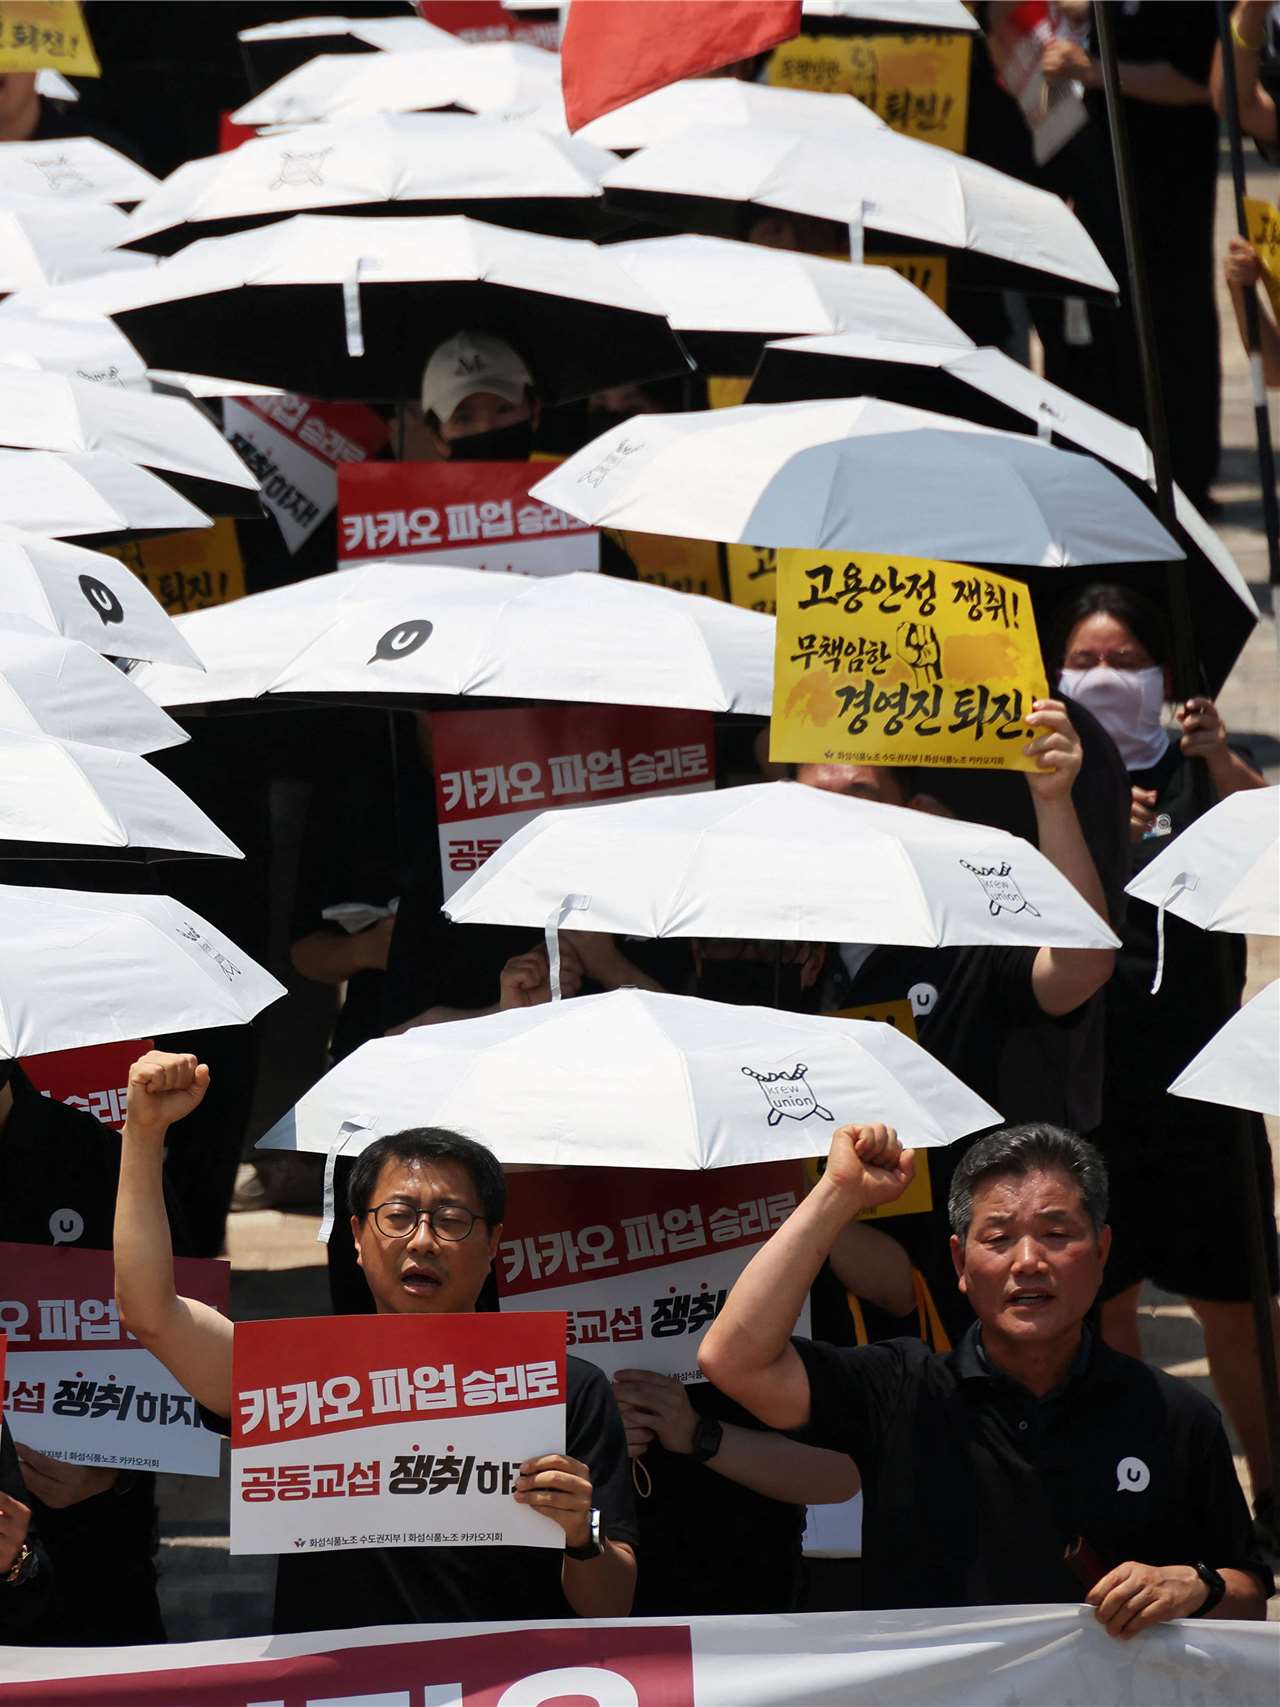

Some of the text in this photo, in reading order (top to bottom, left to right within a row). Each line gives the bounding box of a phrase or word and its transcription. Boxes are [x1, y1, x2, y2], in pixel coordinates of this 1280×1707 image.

[342, 509, 442, 551] 카카오
[445, 500, 514, 541] 파업
[798, 562, 938, 617] 고용안정
[951, 577, 1019, 629] 쟁취!
[790, 633, 891, 675] 무책임한
[835, 679, 944, 737] 경영진
[441, 744, 709, 811] 카카오 파업 승리로
[765, 1085, 799, 1095] krew
[773, 1096, 813, 1108] union
[501, 1192, 797, 1283] 카카오 파업 승리로
[37, 1299, 122, 1341] 파업
[238, 1360, 559, 1434] 카카오 파업 승리로
[120, 1456, 160, 1467] 카카오지회
[241, 1461, 381, 1503] 공동교섭
[309, 1532, 503, 1547] 화섬식품노조 수도권지부 화섬식품노조 카카오지회
